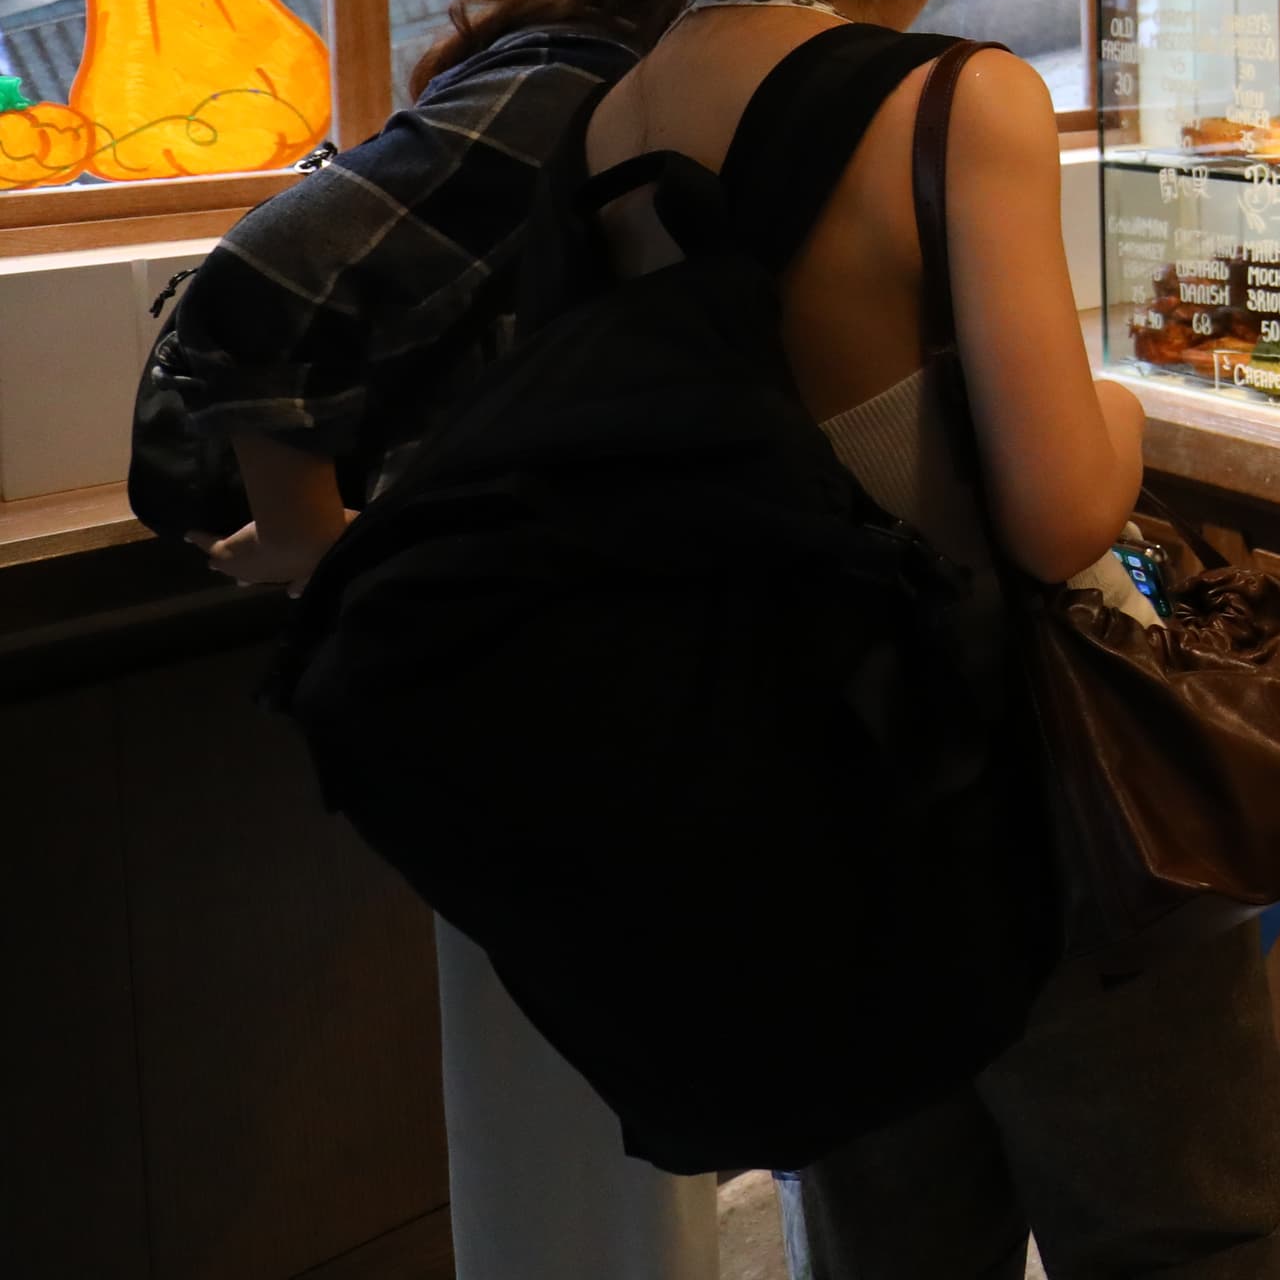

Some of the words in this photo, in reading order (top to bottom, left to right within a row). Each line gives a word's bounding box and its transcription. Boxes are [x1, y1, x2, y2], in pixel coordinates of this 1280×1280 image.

[1114, 72, 1133, 96] 30
[1179, 282, 1231, 307] DANISH
[1192, 312, 1212, 336] 68
[1261, 320, 1280, 343] 50
